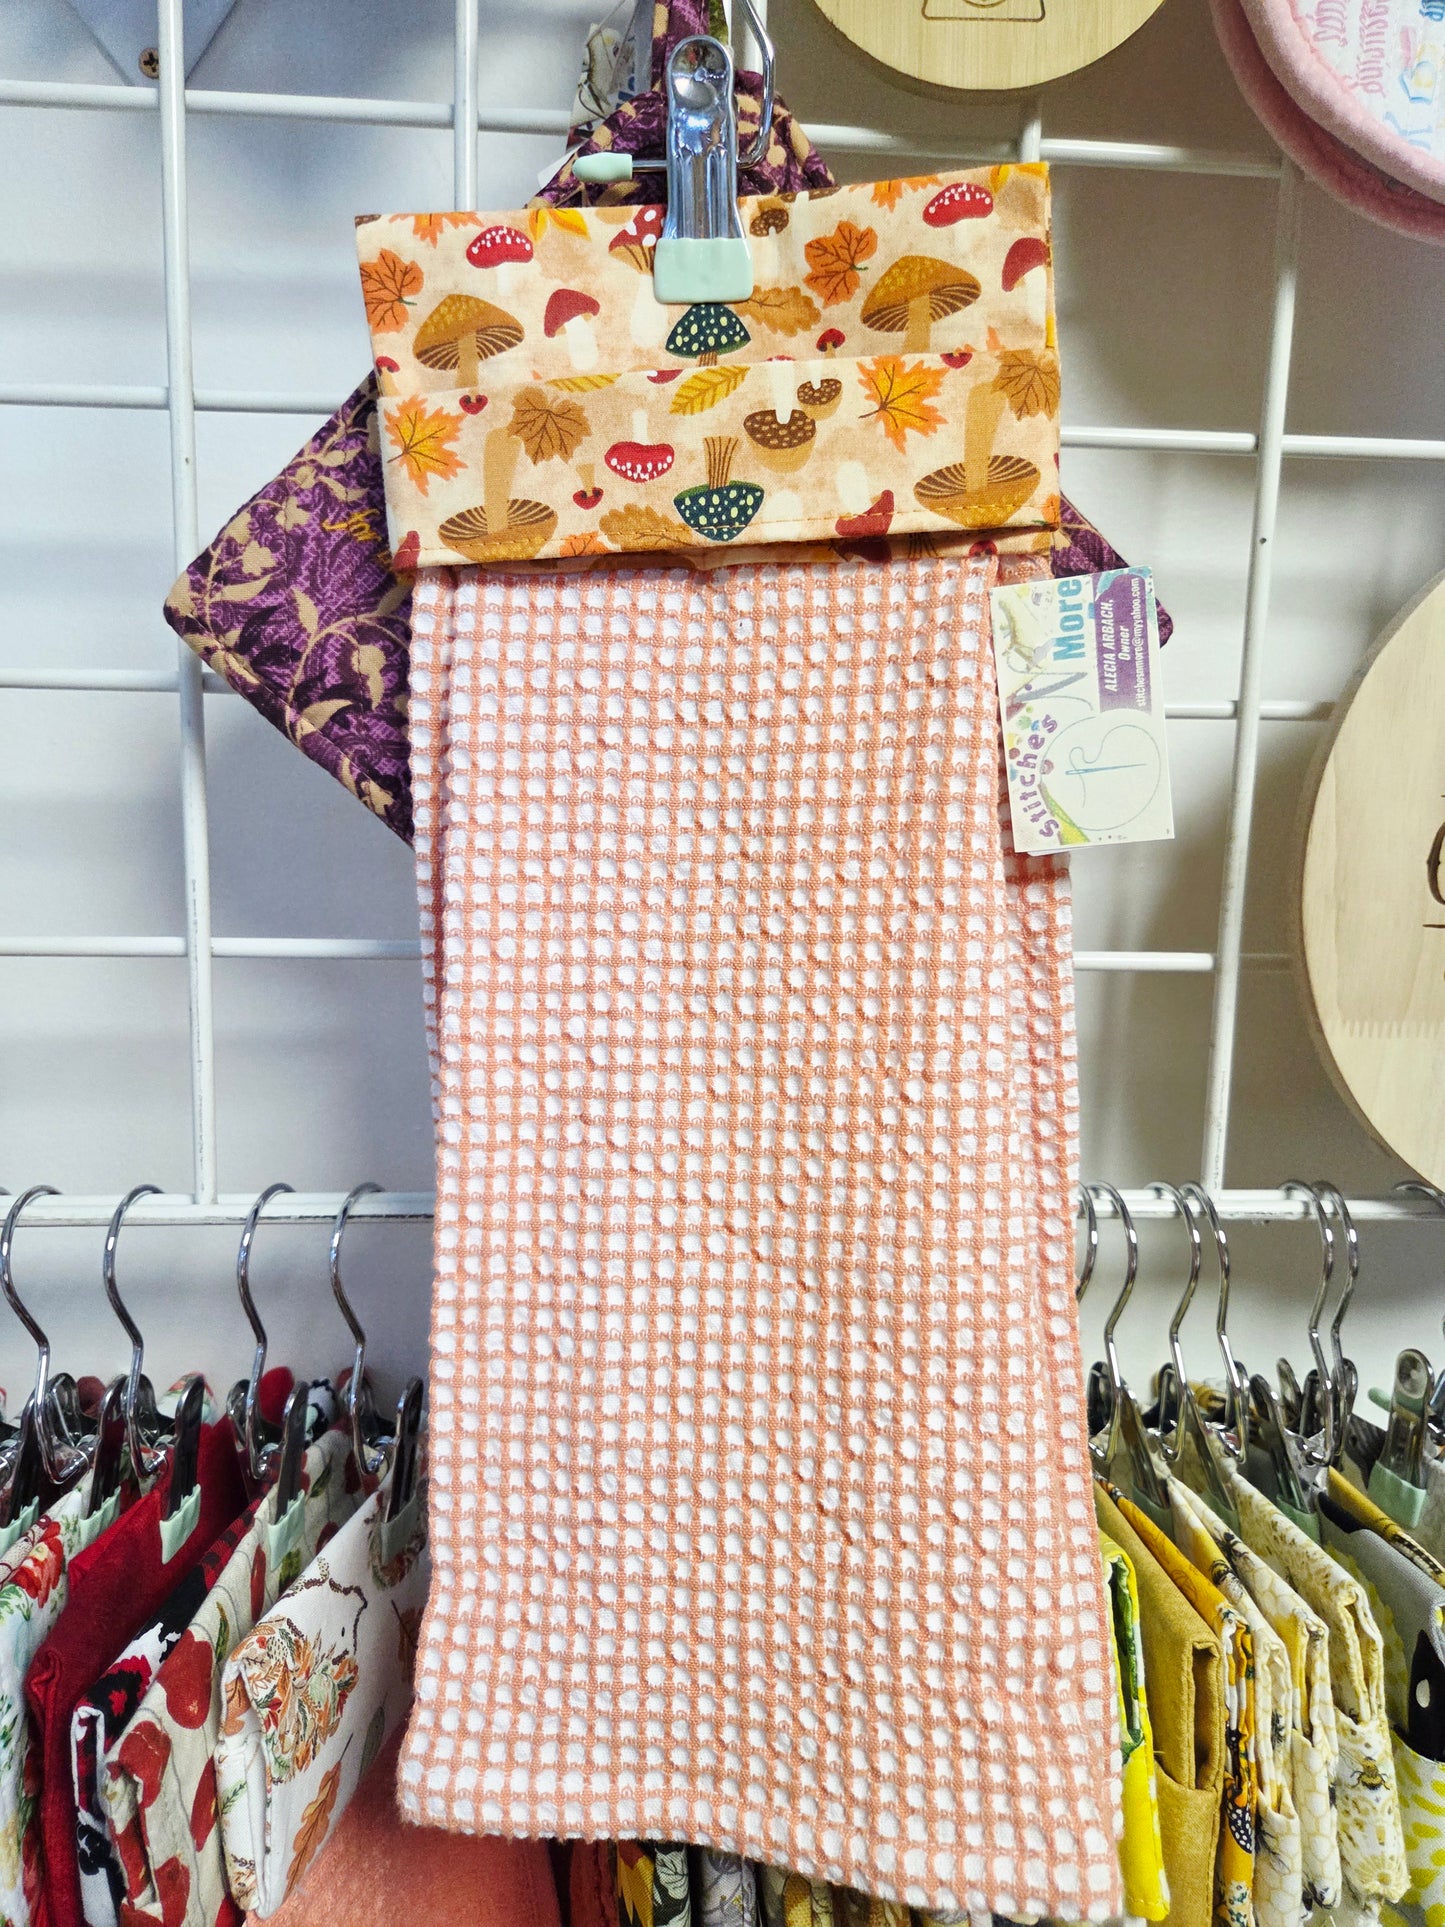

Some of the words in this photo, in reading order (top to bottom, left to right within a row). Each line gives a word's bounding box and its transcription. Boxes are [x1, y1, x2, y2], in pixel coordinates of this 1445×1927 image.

[1053, 578, 1087, 662] More
[1100, 599, 1116, 651] ARBACH,
[1117, 624, 1131, 661] Owner
[1130, 577, 1147, 707] stitchesnmore@myyahoo.com
[1102, 651, 1118, 692] ALECIA
